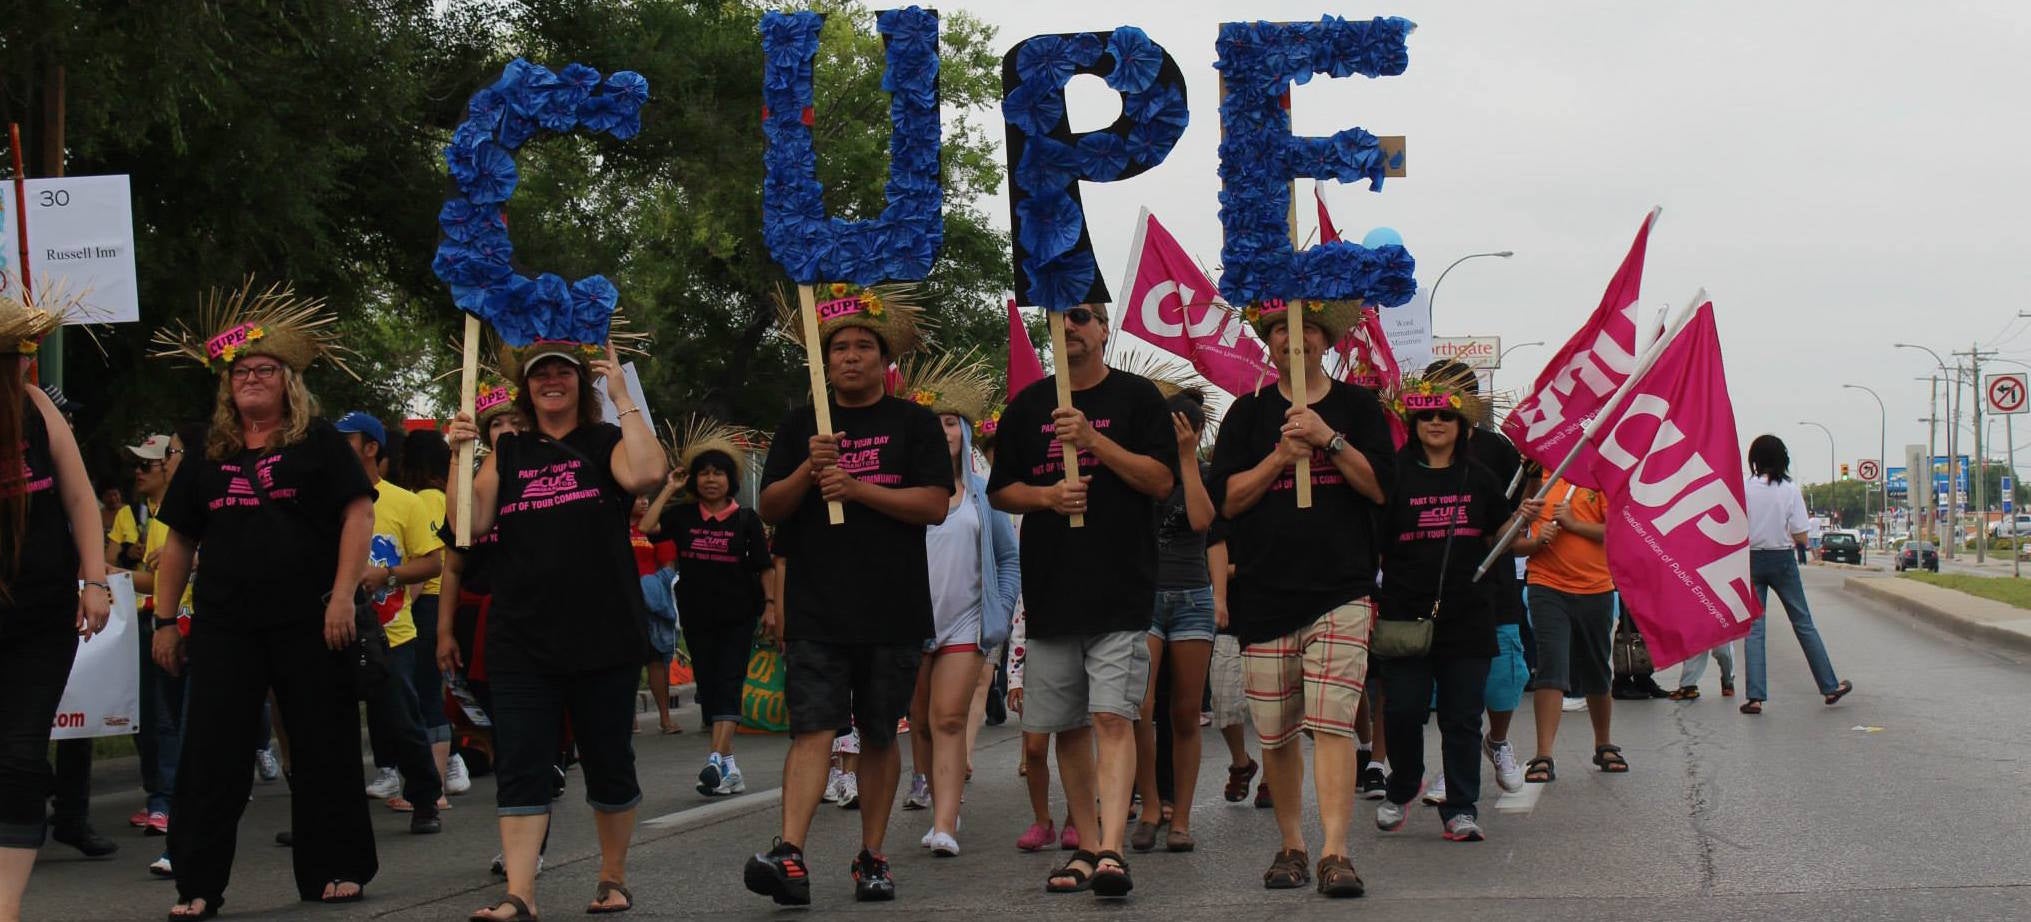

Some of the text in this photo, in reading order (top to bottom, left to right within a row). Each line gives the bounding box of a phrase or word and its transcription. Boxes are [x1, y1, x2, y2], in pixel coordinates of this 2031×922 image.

[40, 189, 69, 207] 30
[47, 246, 116, 260] Russell Inn
[820, 299, 863, 317] CUPE
[210, 328, 246, 355] CUPE
[1432, 341, 1493, 358] rthgate
[1406, 396, 1444, 407] CUPE
[1042, 424, 1056, 432] PAR
[1095, 419, 1110, 428] DAY
[841, 436, 889, 448] OF YOUR DAY
[841, 449, 880, 463] CUPE
[518, 470, 538, 479] PART
[226, 497, 237, 506] OF
[238, 497, 260, 506] YOUR
[518, 502, 530, 511] OF
[532, 499, 554, 510] YOUR
[1410, 496, 1428, 506] PART
[1429, 496, 1438, 504] OF
[1439, 495, 1458, 504] YOUR
[1645, 534, 1664, 557] Union
[1661, 553, 1673, 564] of
[1671, 561, 1694, 587] Public
[1692, 585, 1729, 629] Employees
